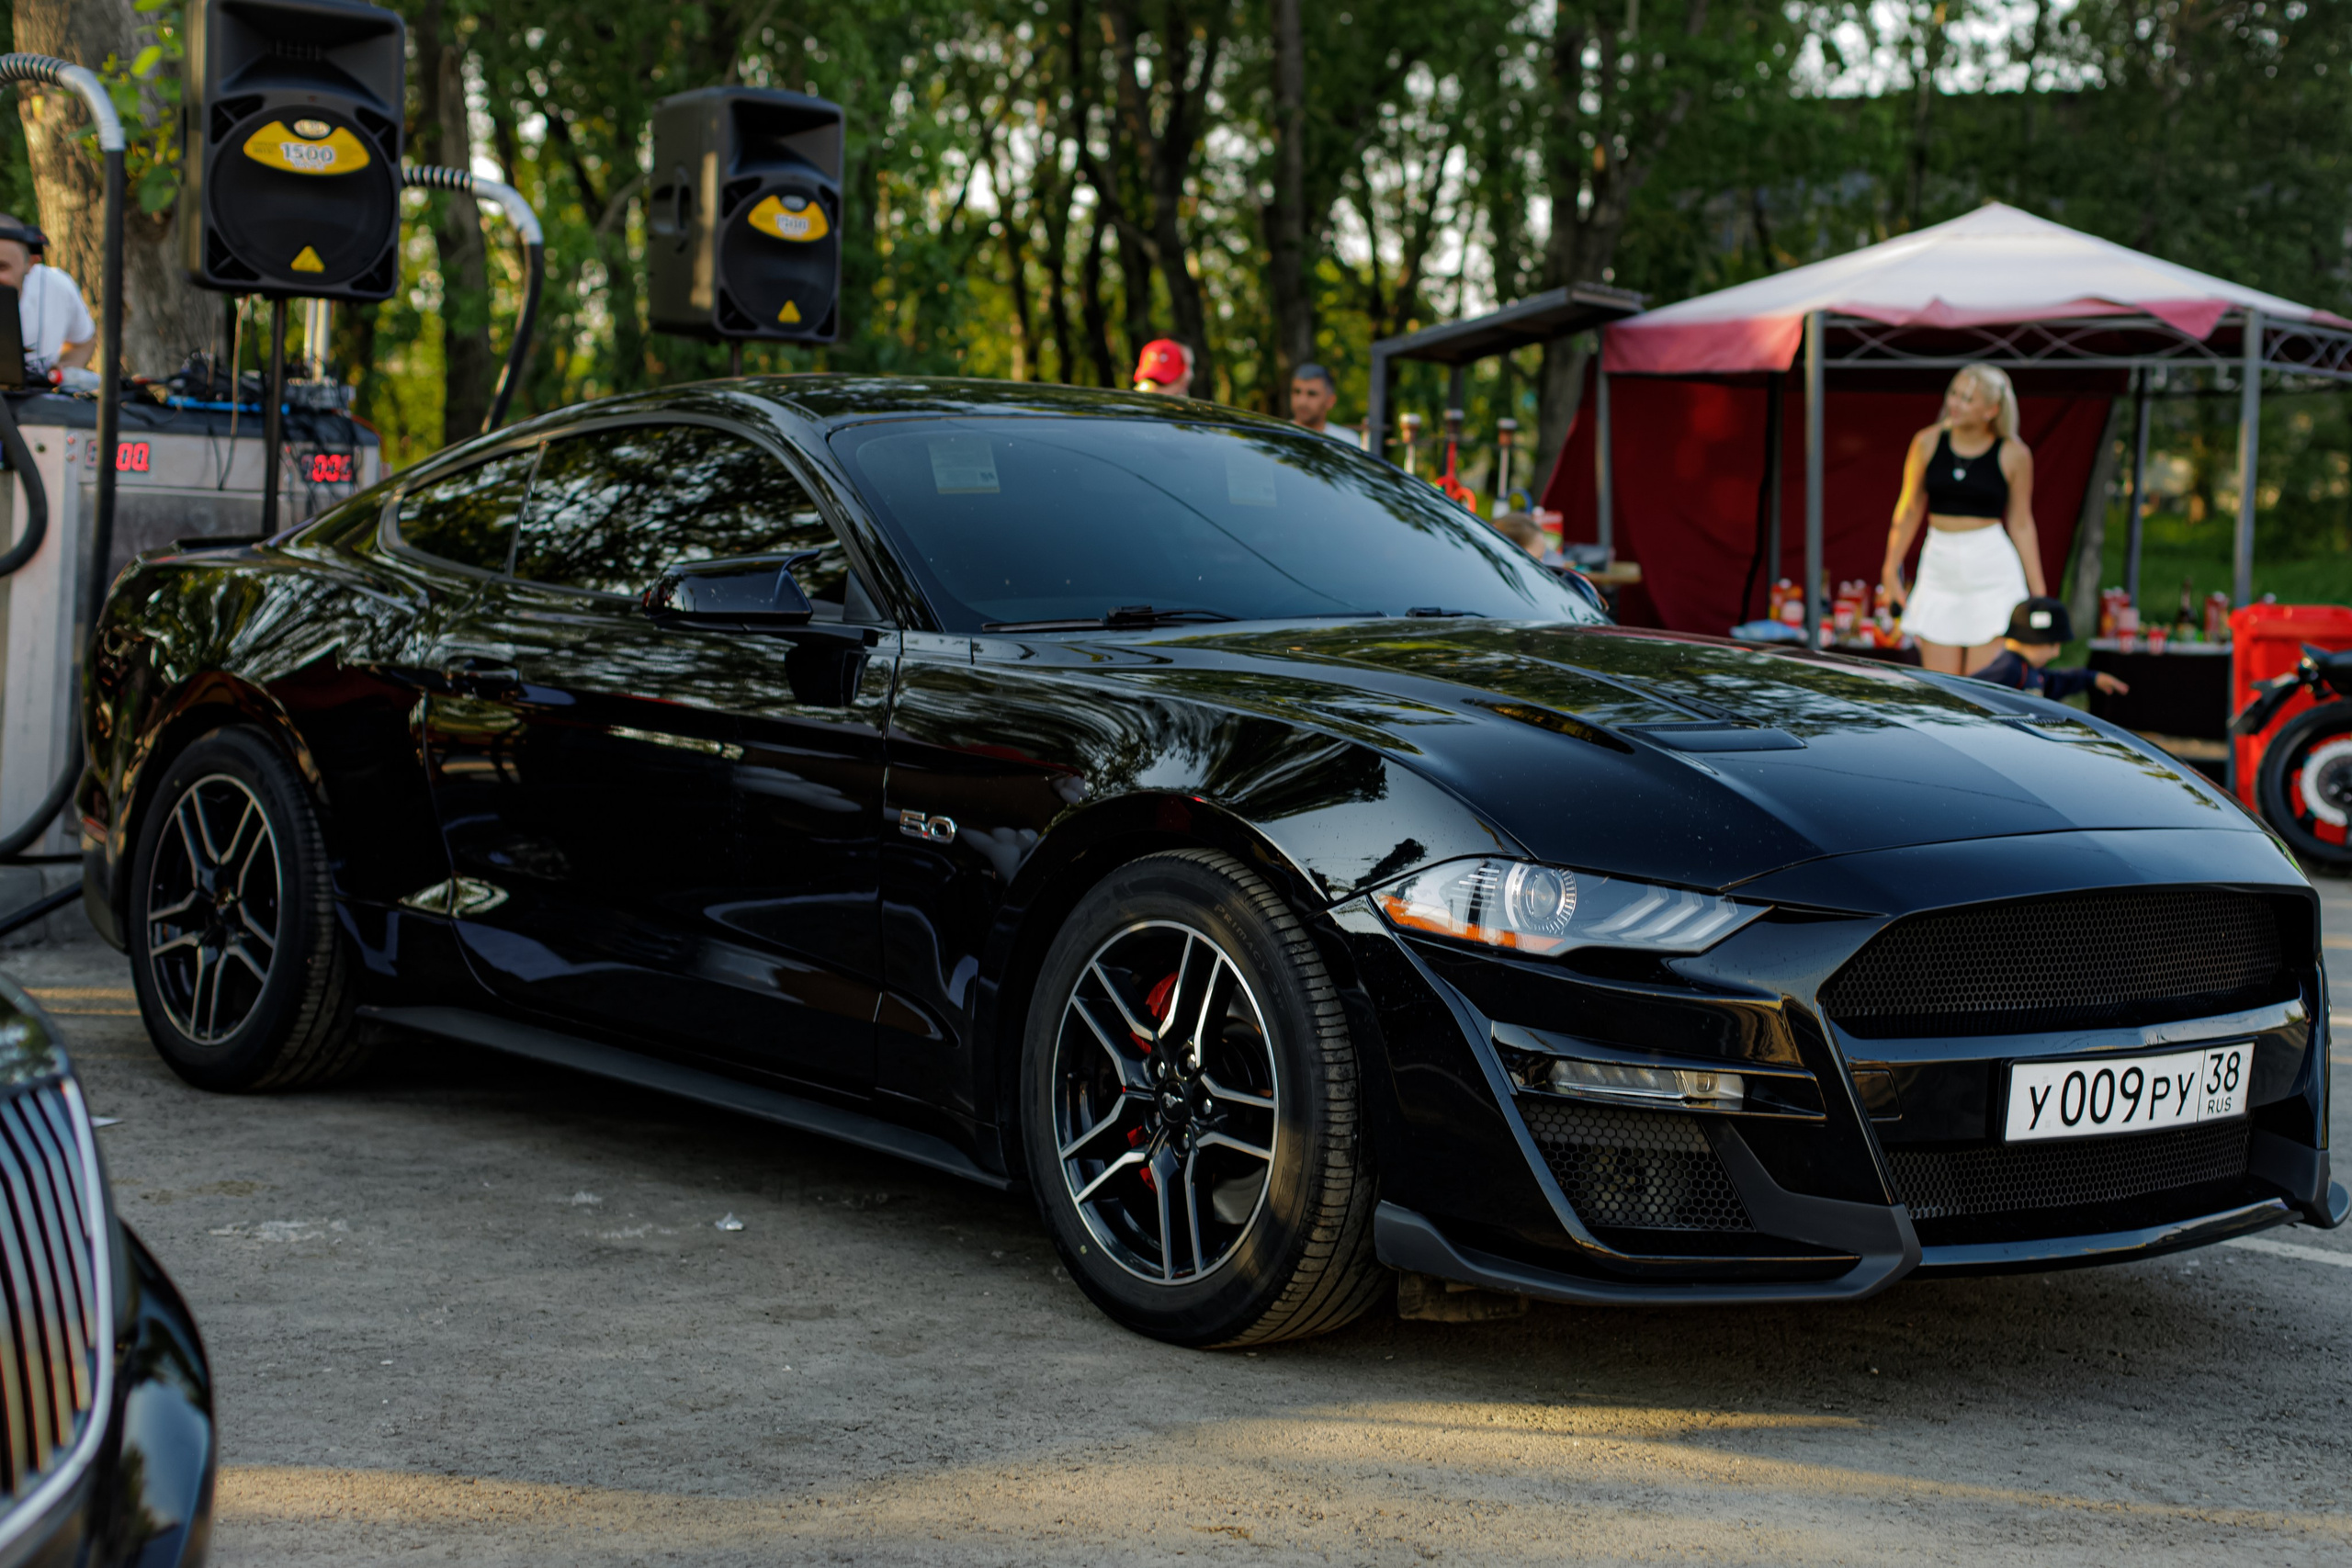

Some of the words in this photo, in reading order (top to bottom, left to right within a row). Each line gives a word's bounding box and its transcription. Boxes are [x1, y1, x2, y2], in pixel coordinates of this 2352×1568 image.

[280, 142, 334, 164] 1500
[899, 809, 956, 844] 5.0
[1214, 903, 1269, 973] PRIMACY
[2206, 1051, 2241, 1095] 38
[2207, 1097, 2232, 1115] RUS
